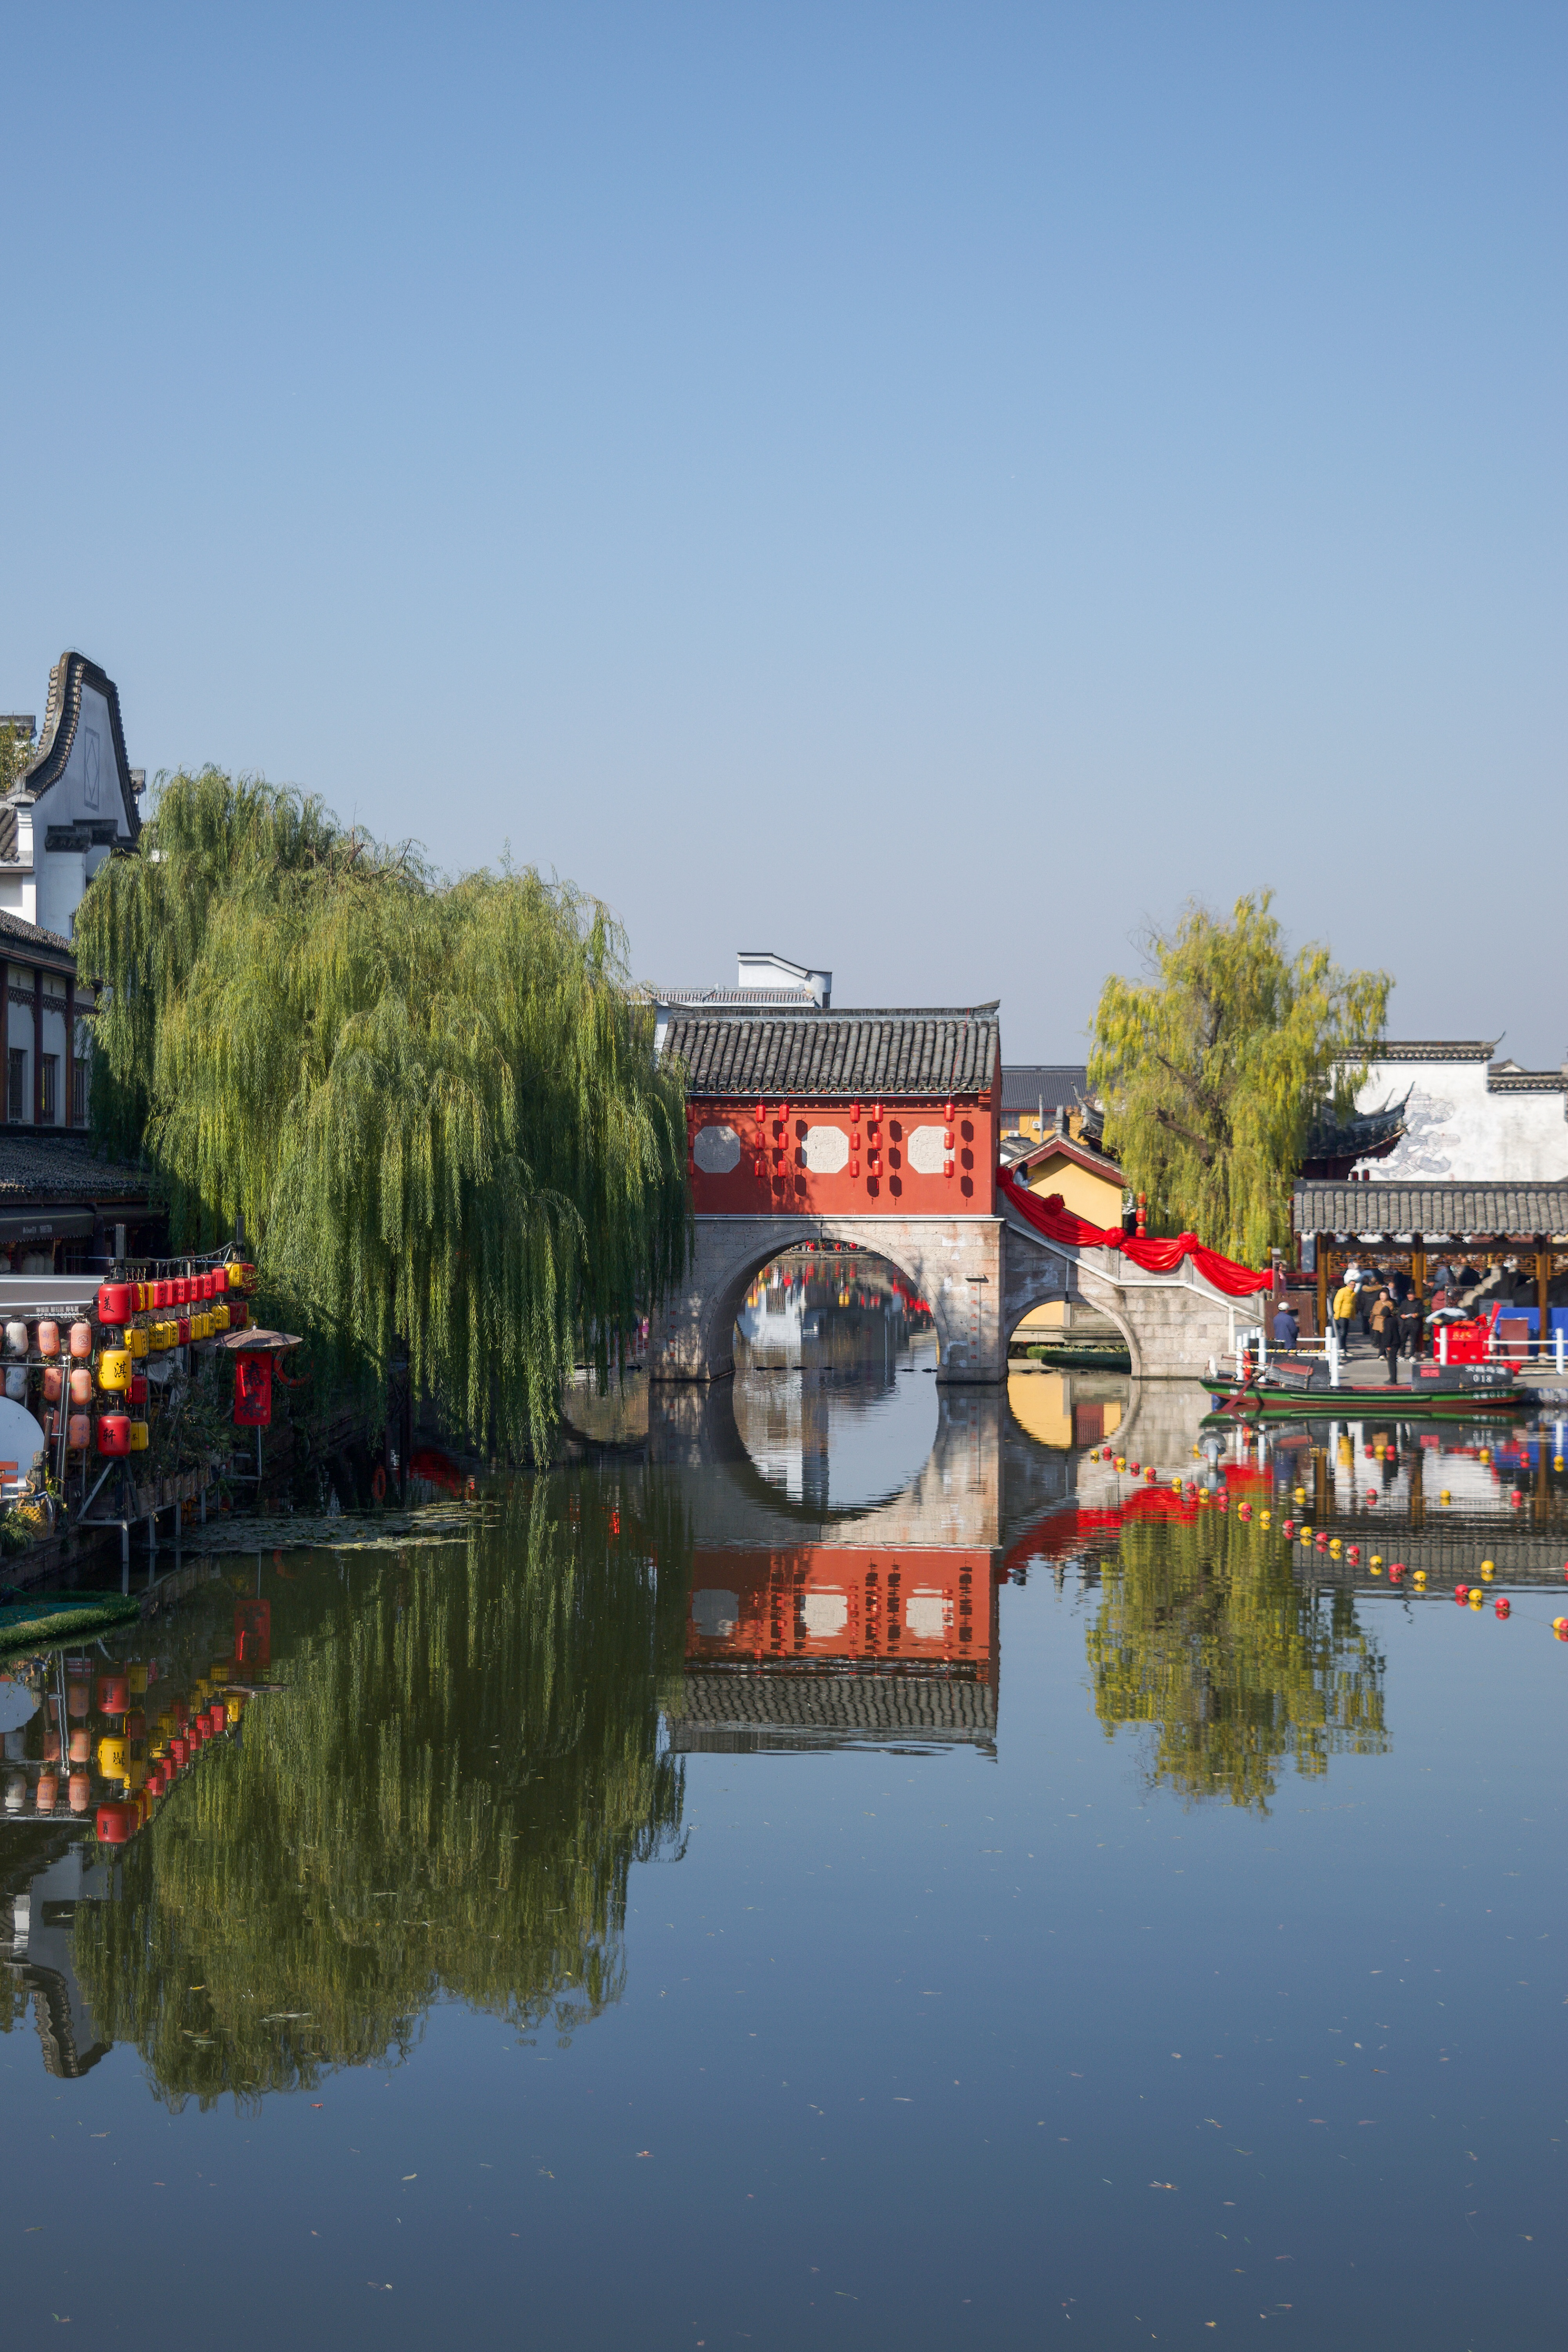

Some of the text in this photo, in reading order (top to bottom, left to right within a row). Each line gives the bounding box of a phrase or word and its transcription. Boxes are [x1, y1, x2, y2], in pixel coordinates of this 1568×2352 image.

[114, 1361, 127, 1379] 淇
[1473, 1374, 1493, 1383] 018
[103, 1427, 116, 1445] 轩
